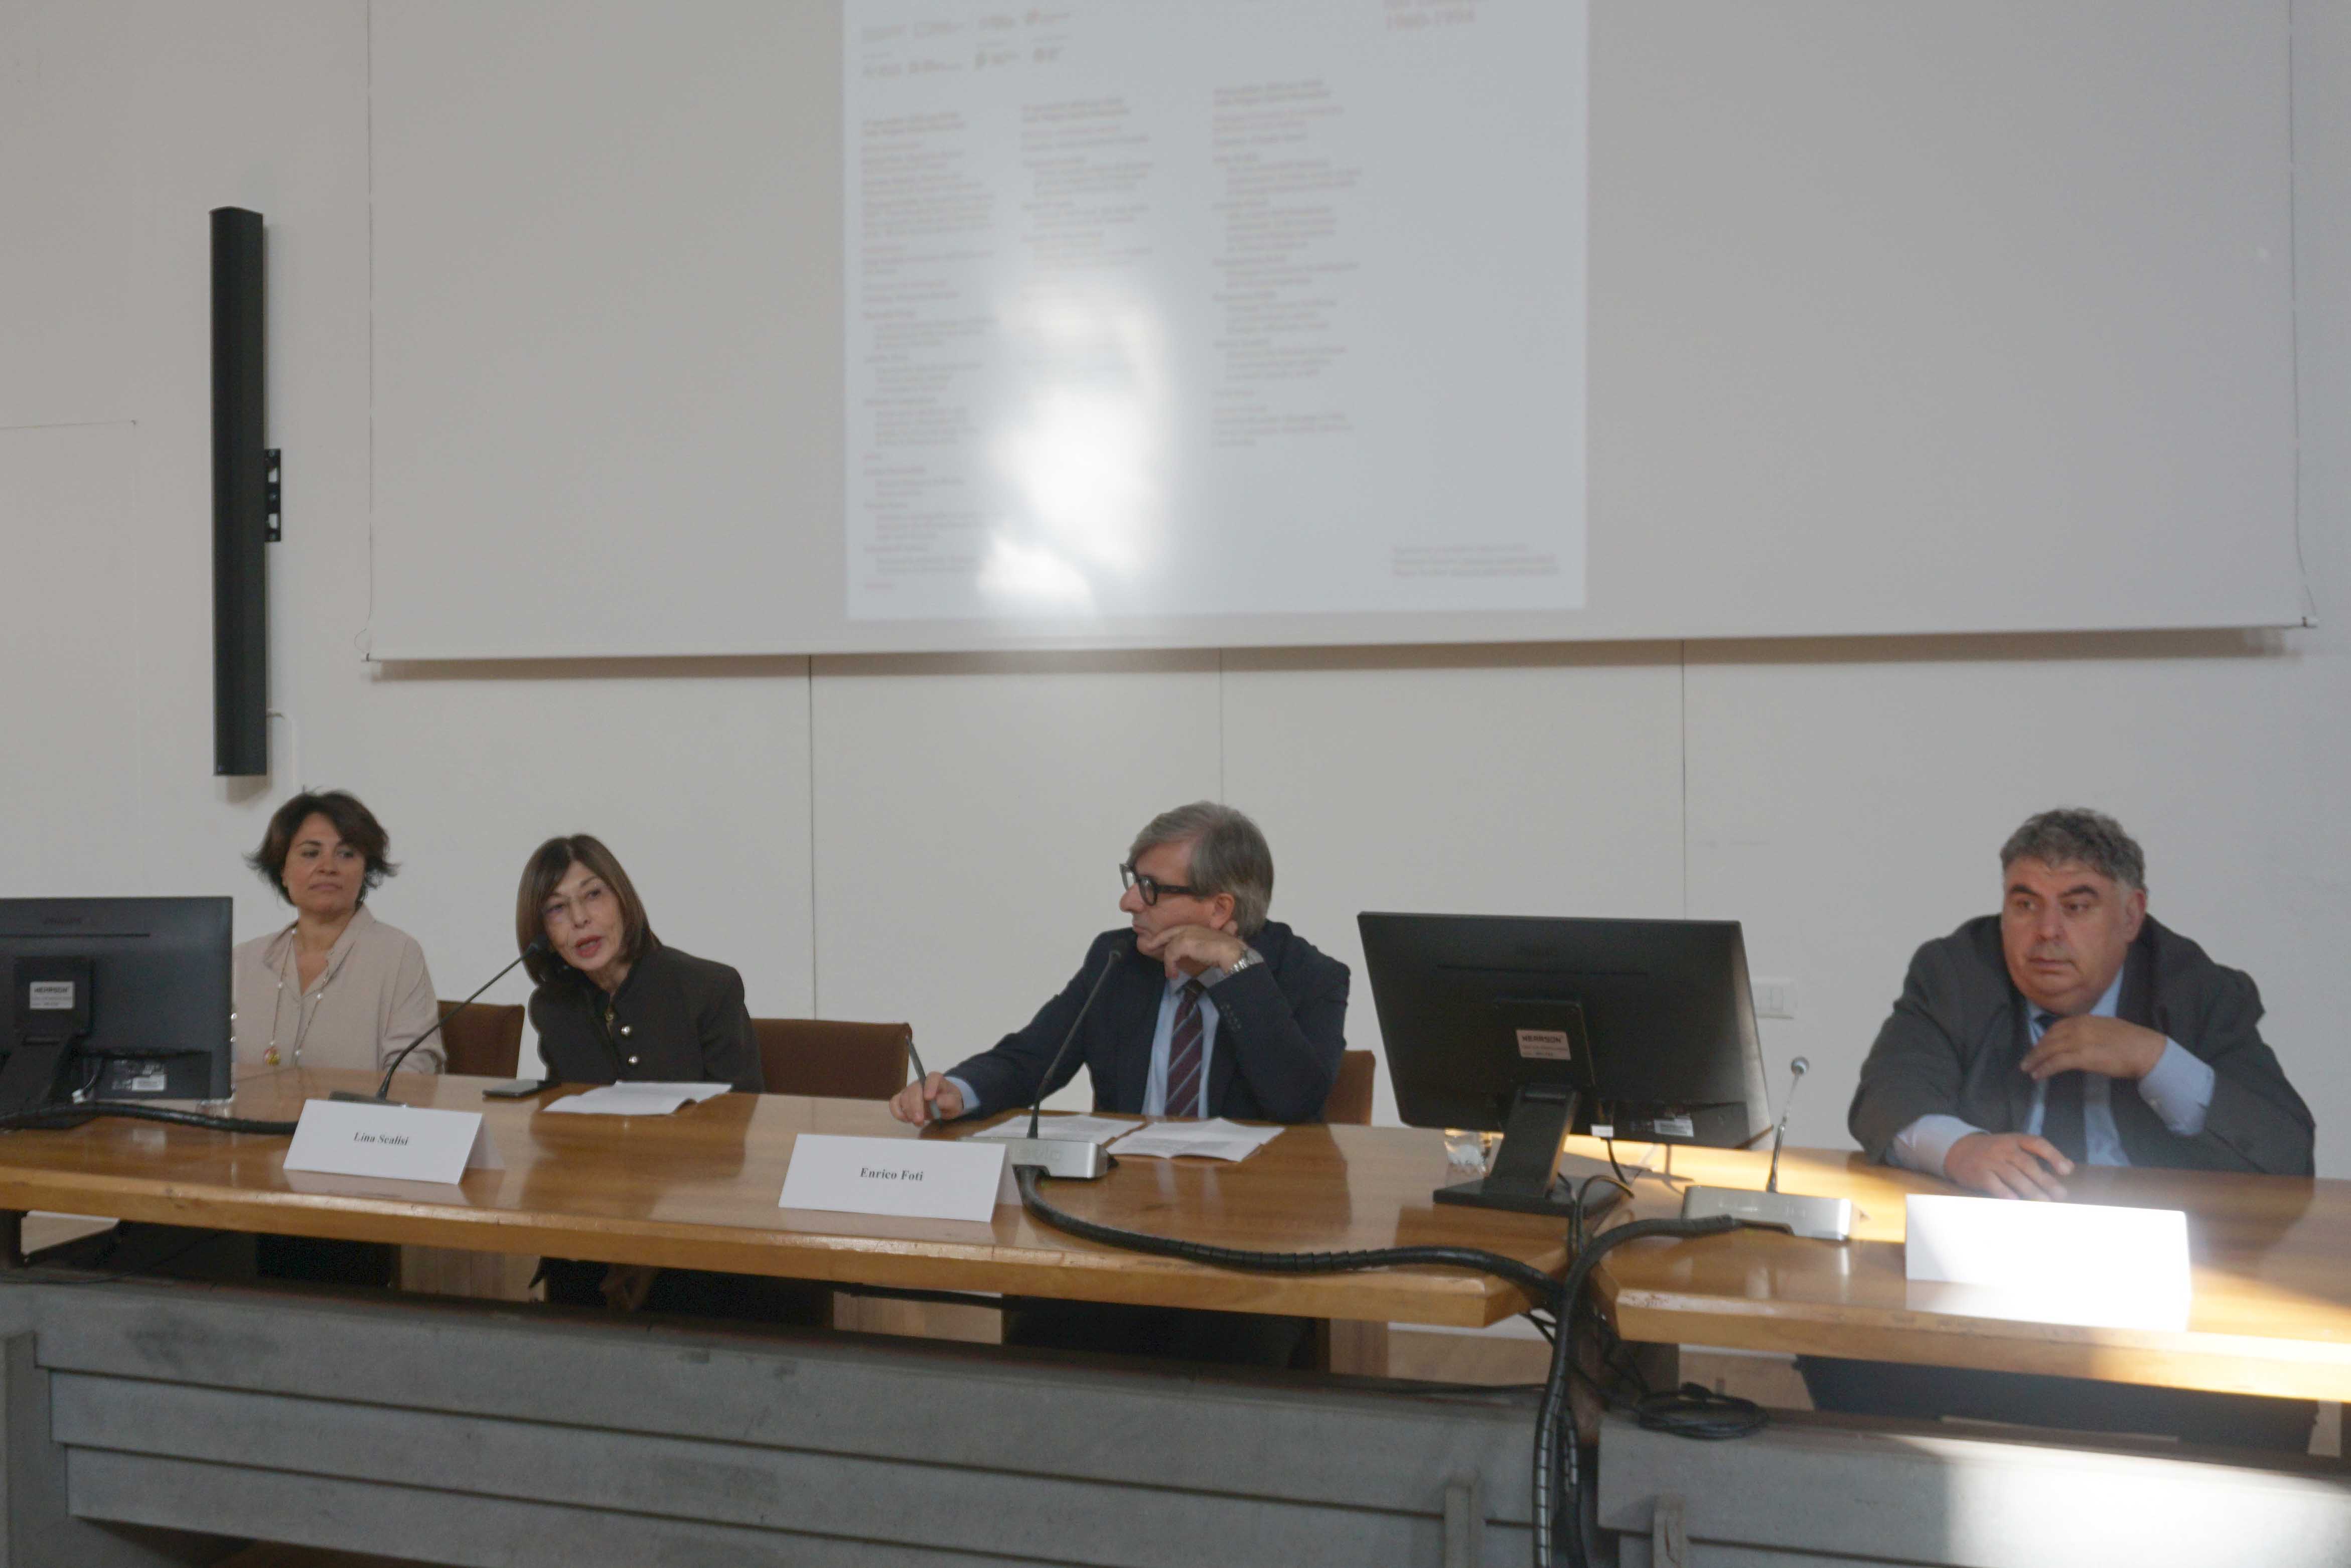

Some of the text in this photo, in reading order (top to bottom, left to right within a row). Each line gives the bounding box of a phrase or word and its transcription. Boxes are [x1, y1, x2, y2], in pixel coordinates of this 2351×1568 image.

[353, 1131, 409, 1146] Lina Scalisi
[859, 1167, 924, 1181] Enrico Foti
